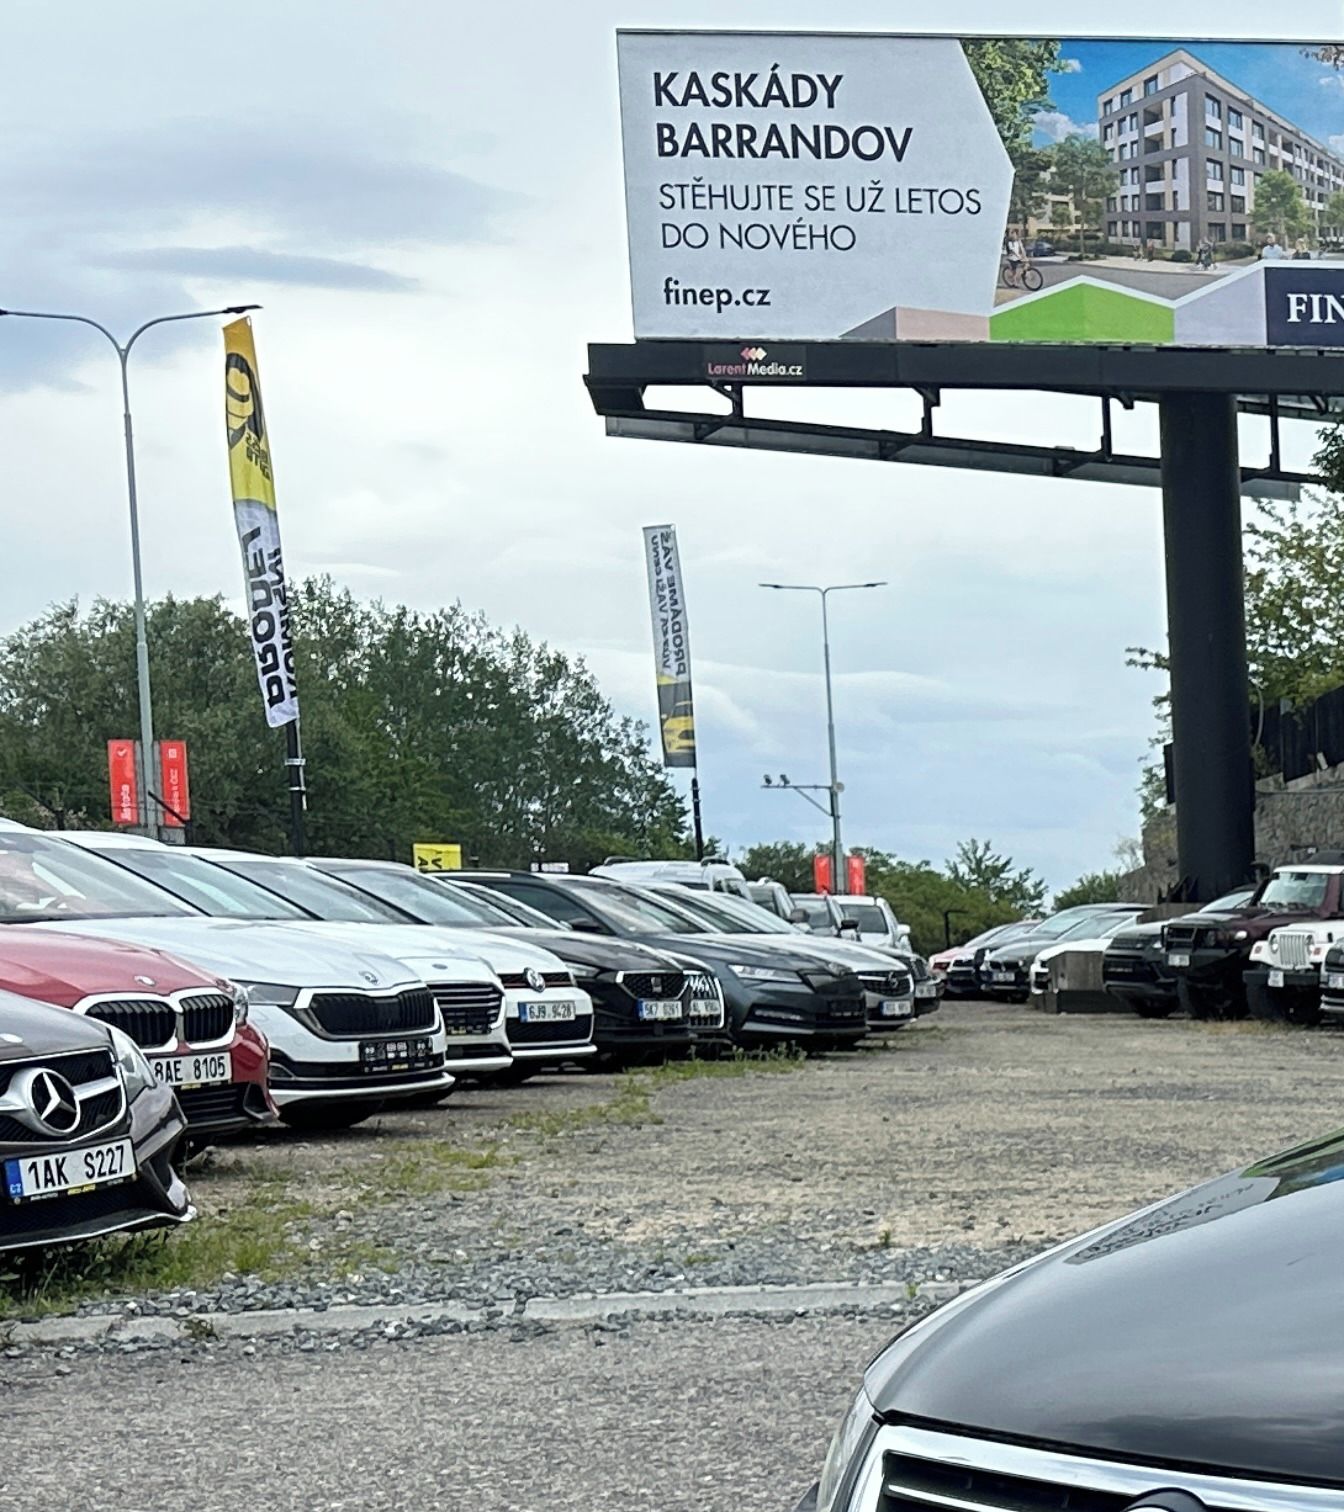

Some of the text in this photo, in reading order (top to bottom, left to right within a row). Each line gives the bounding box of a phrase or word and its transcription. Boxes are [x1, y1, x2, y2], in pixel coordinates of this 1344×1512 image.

[653, 62, 844, 109] KASKÁDY
[656, 122, 914, 163] BARRANDOV
[659, 176, 982, 215] STĚHUJTE SE UŽ LETOS
[661, 217, 857, 252] DO NOVÉHO
[663, 276, 772, 314] finep.cz
[707, 362, 804, 376] LarentMedia.cz
[193, 1055, 226, 1080] 8105
[27, 1144, 125, 1190] 1AK S227
